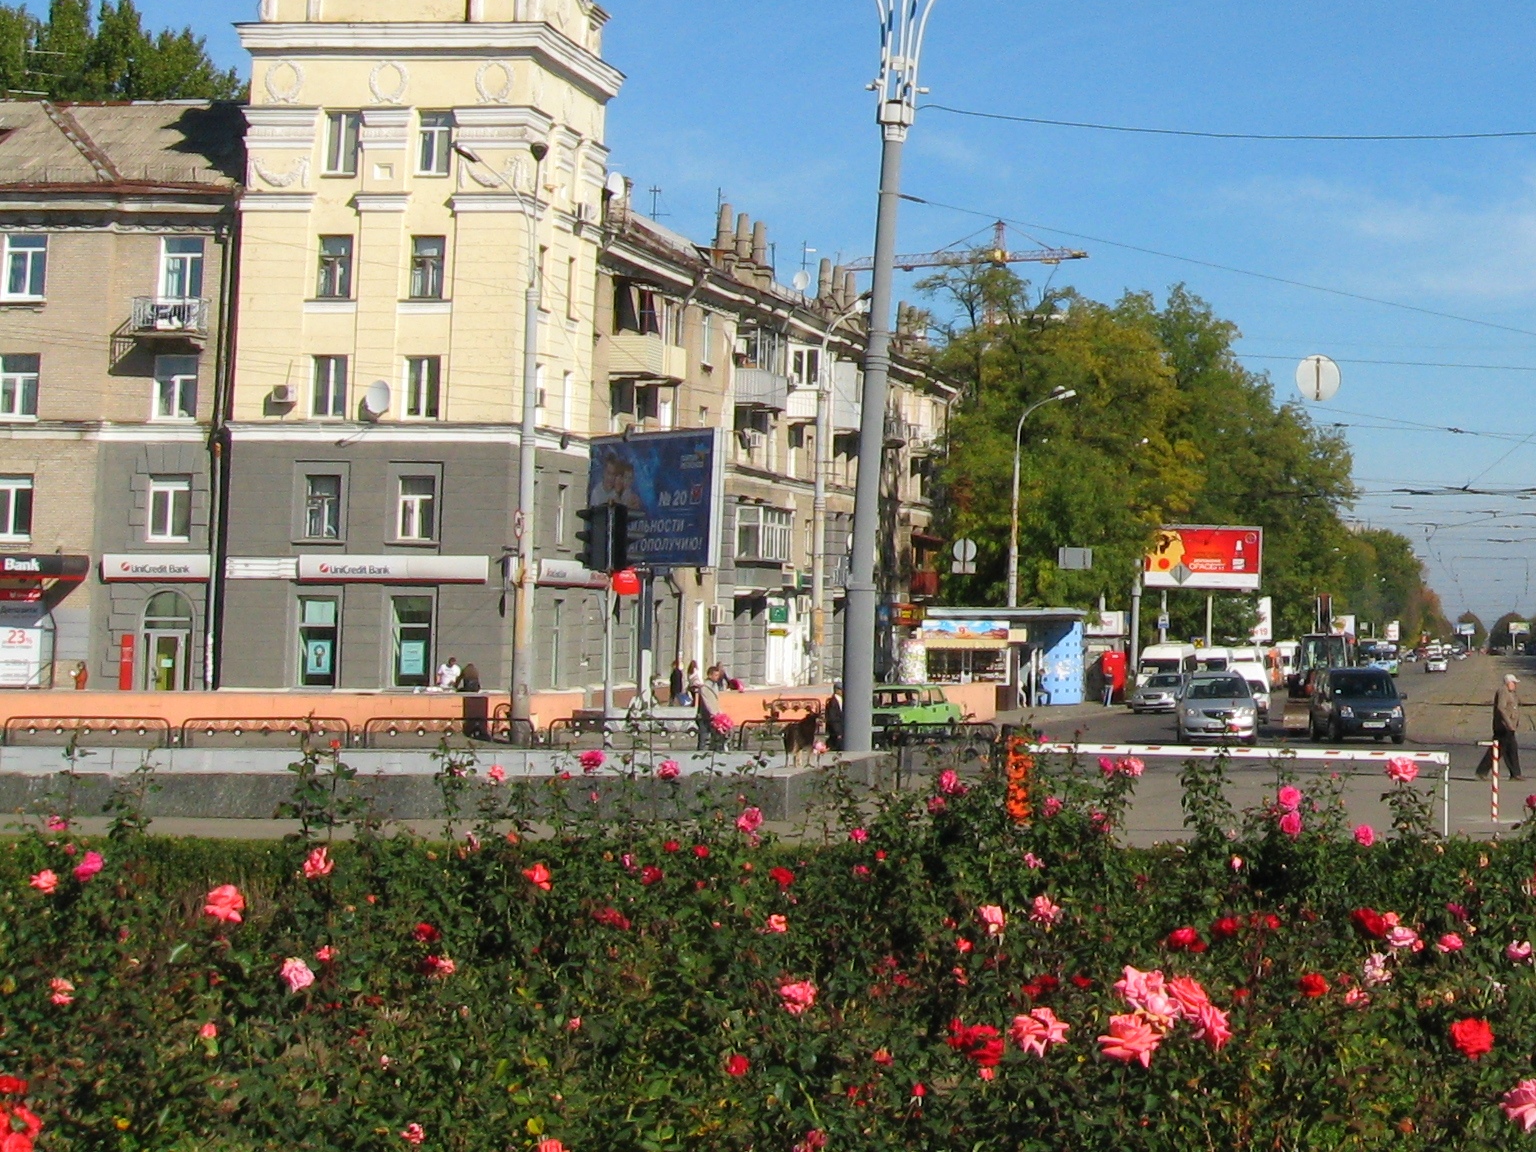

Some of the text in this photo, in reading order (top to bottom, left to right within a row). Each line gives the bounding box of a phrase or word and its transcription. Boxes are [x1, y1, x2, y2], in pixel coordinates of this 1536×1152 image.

[672, 489, 688, 506] 20
[628, 519, 685, 533] ИЛЬНОСТИ
[628, 537, 704, 552] АГОПОЛУЧИЮ!
[4, 557, 40, 571] Bank
[131, 564, 190, 574] UniCredit Bank
[330, 565, 390, 575] UniCredit Bank
